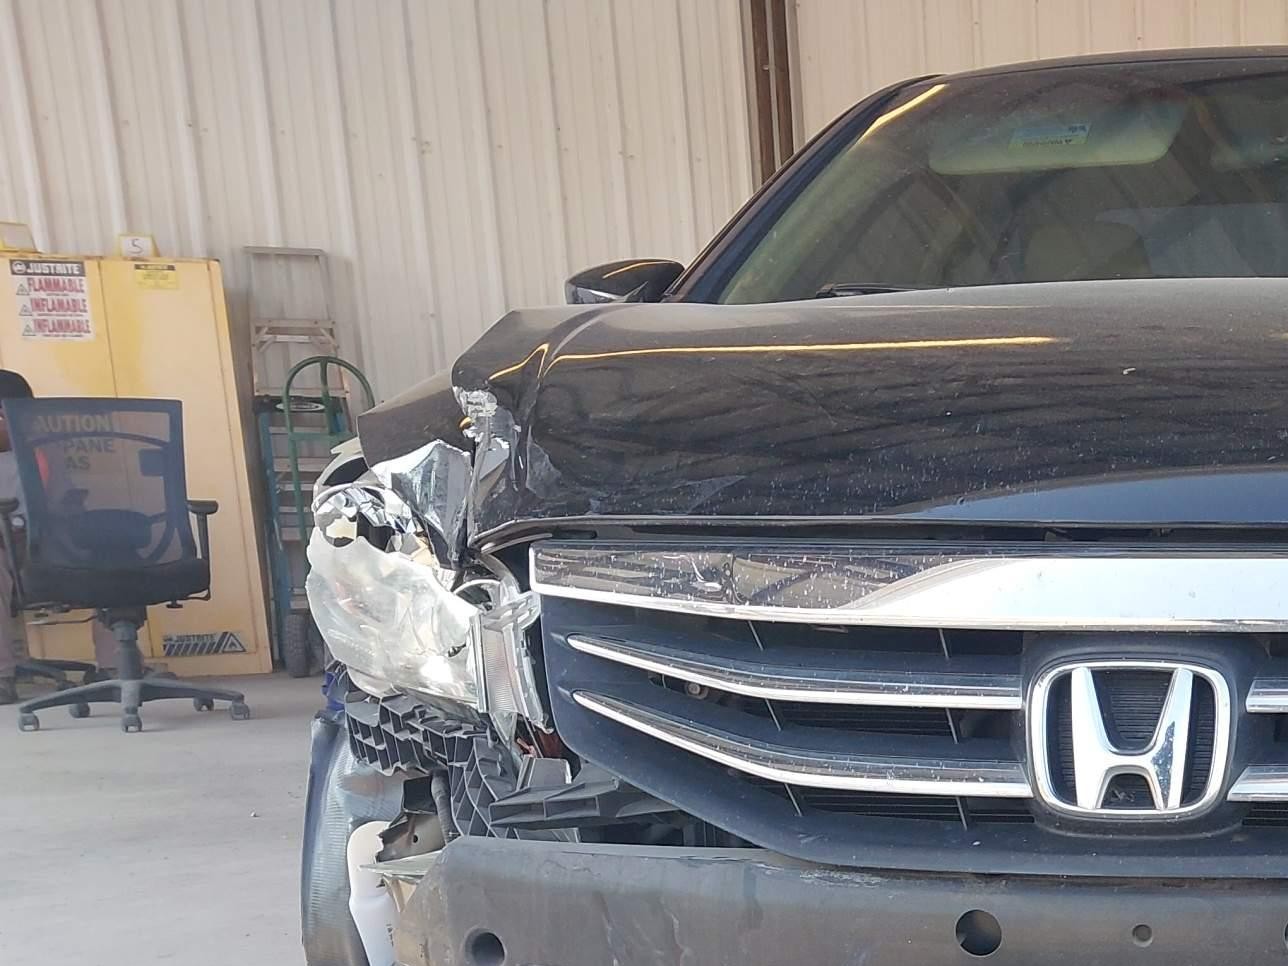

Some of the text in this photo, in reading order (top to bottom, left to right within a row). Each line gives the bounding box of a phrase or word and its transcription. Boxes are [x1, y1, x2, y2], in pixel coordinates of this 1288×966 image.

[26, 263, 82, 274] JUSTRITE
[27, 277, 85, 293] FLAMMABLE
[31, 414, 111, 433] AUTION
